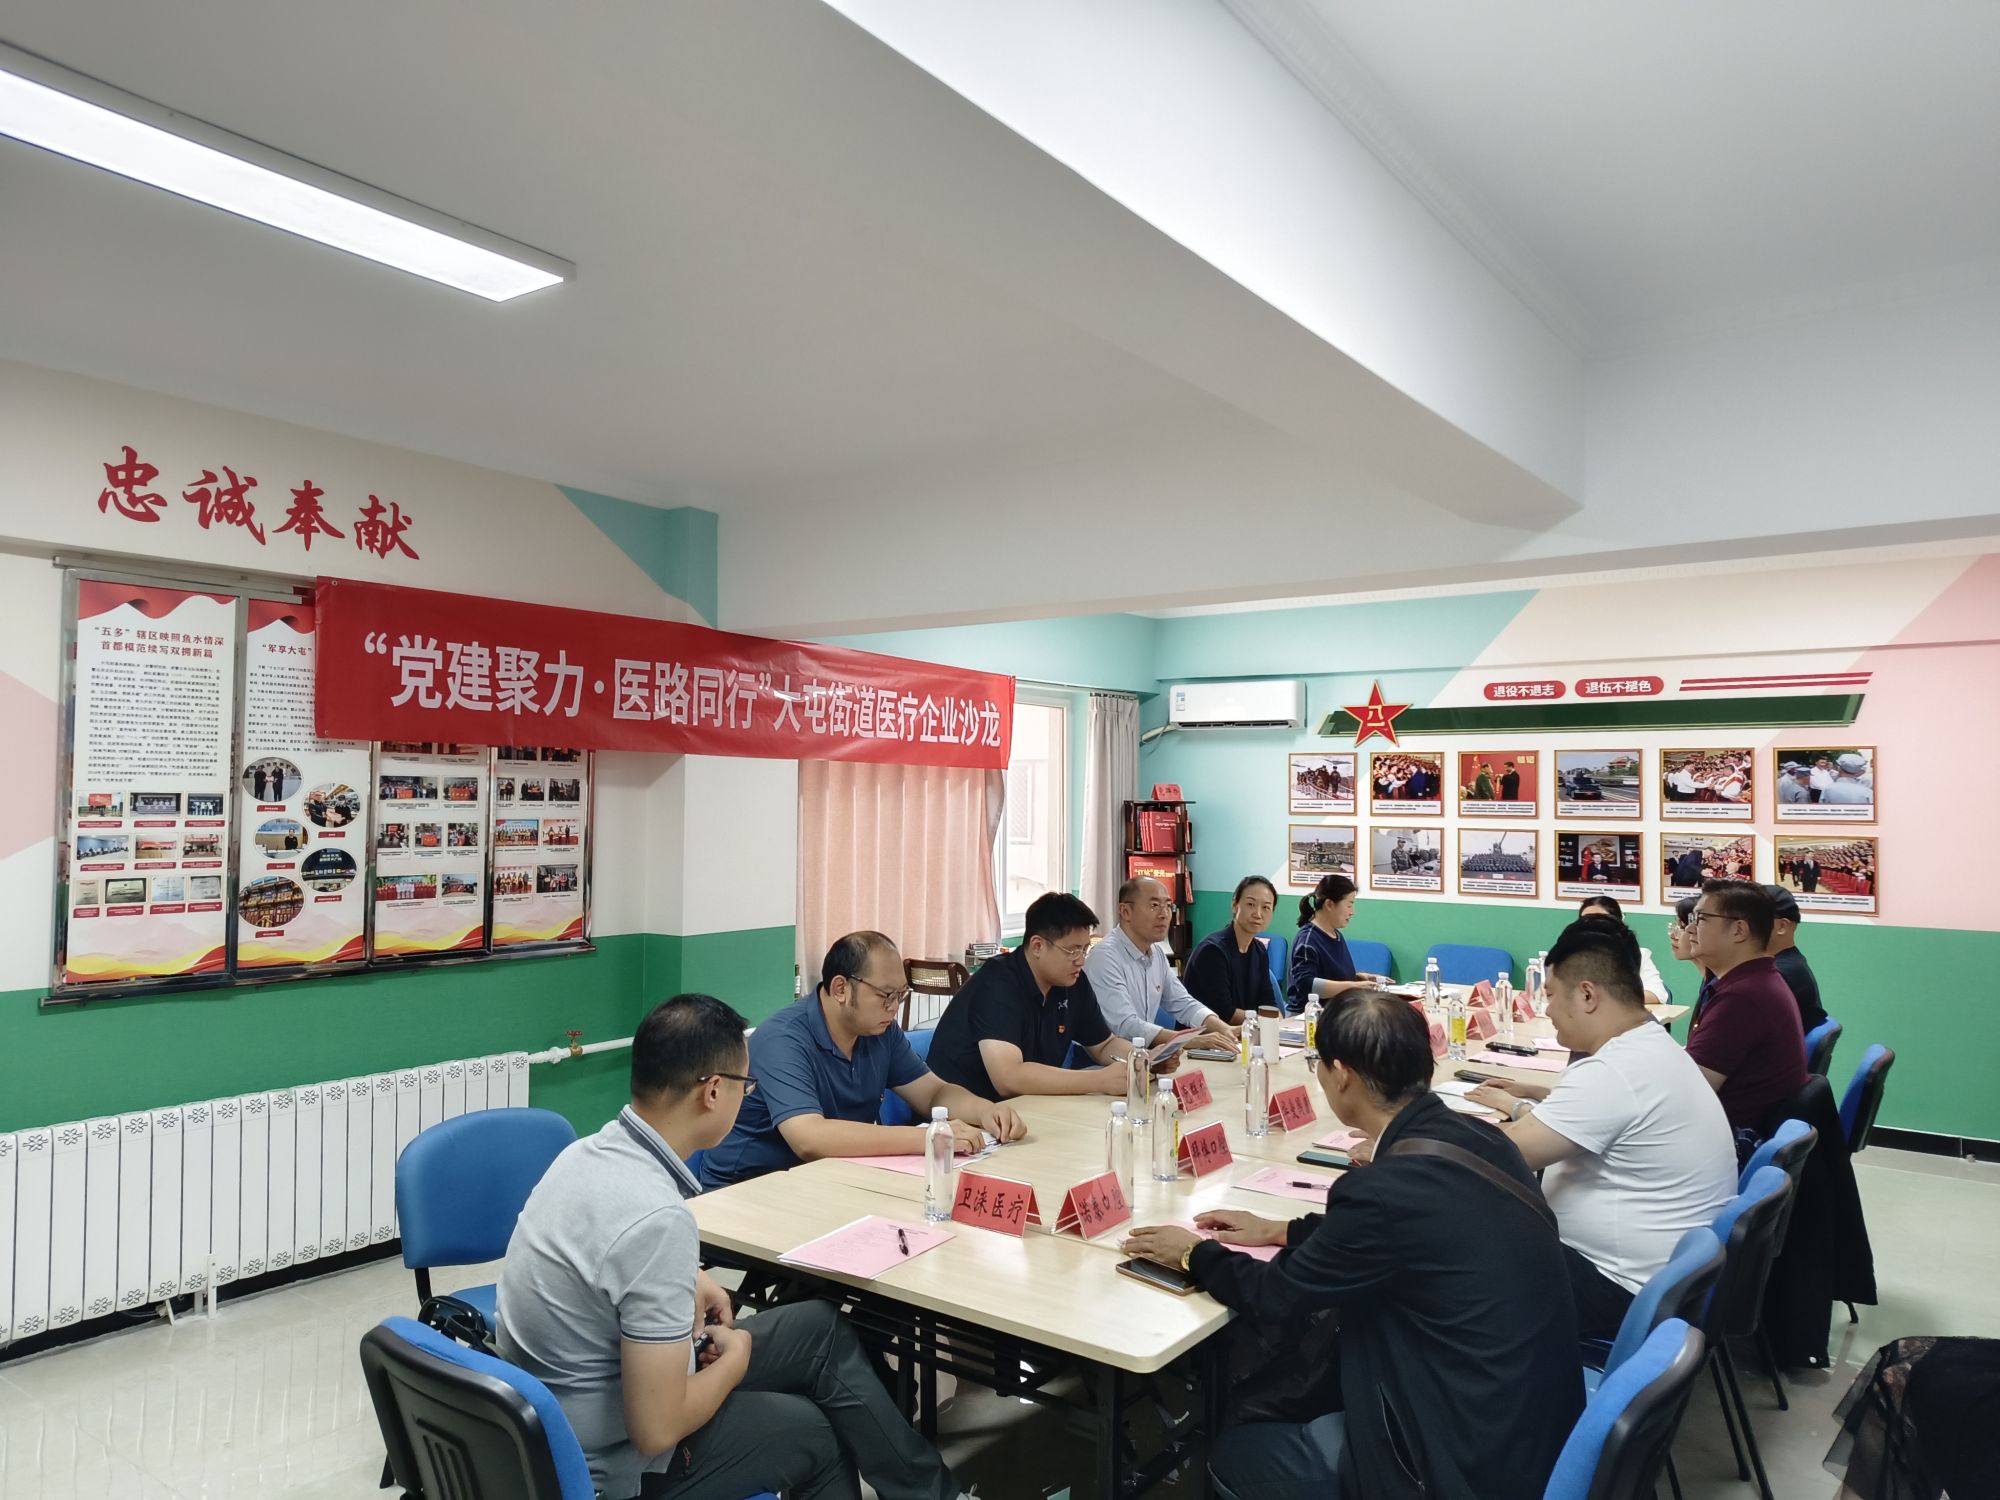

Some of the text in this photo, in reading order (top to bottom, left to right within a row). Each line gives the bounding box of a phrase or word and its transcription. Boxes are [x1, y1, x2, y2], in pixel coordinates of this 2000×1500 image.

[98, 446, 420, 560] 忠诚奉献
[364, 632, 1001, 747] “党建聚力·医路同行”大屯街道医疗企业沙龙
[1367, 705, 1386, 727] 八一
[1493, 680, 1652, 698] 退役不退志 退伍不褪色
